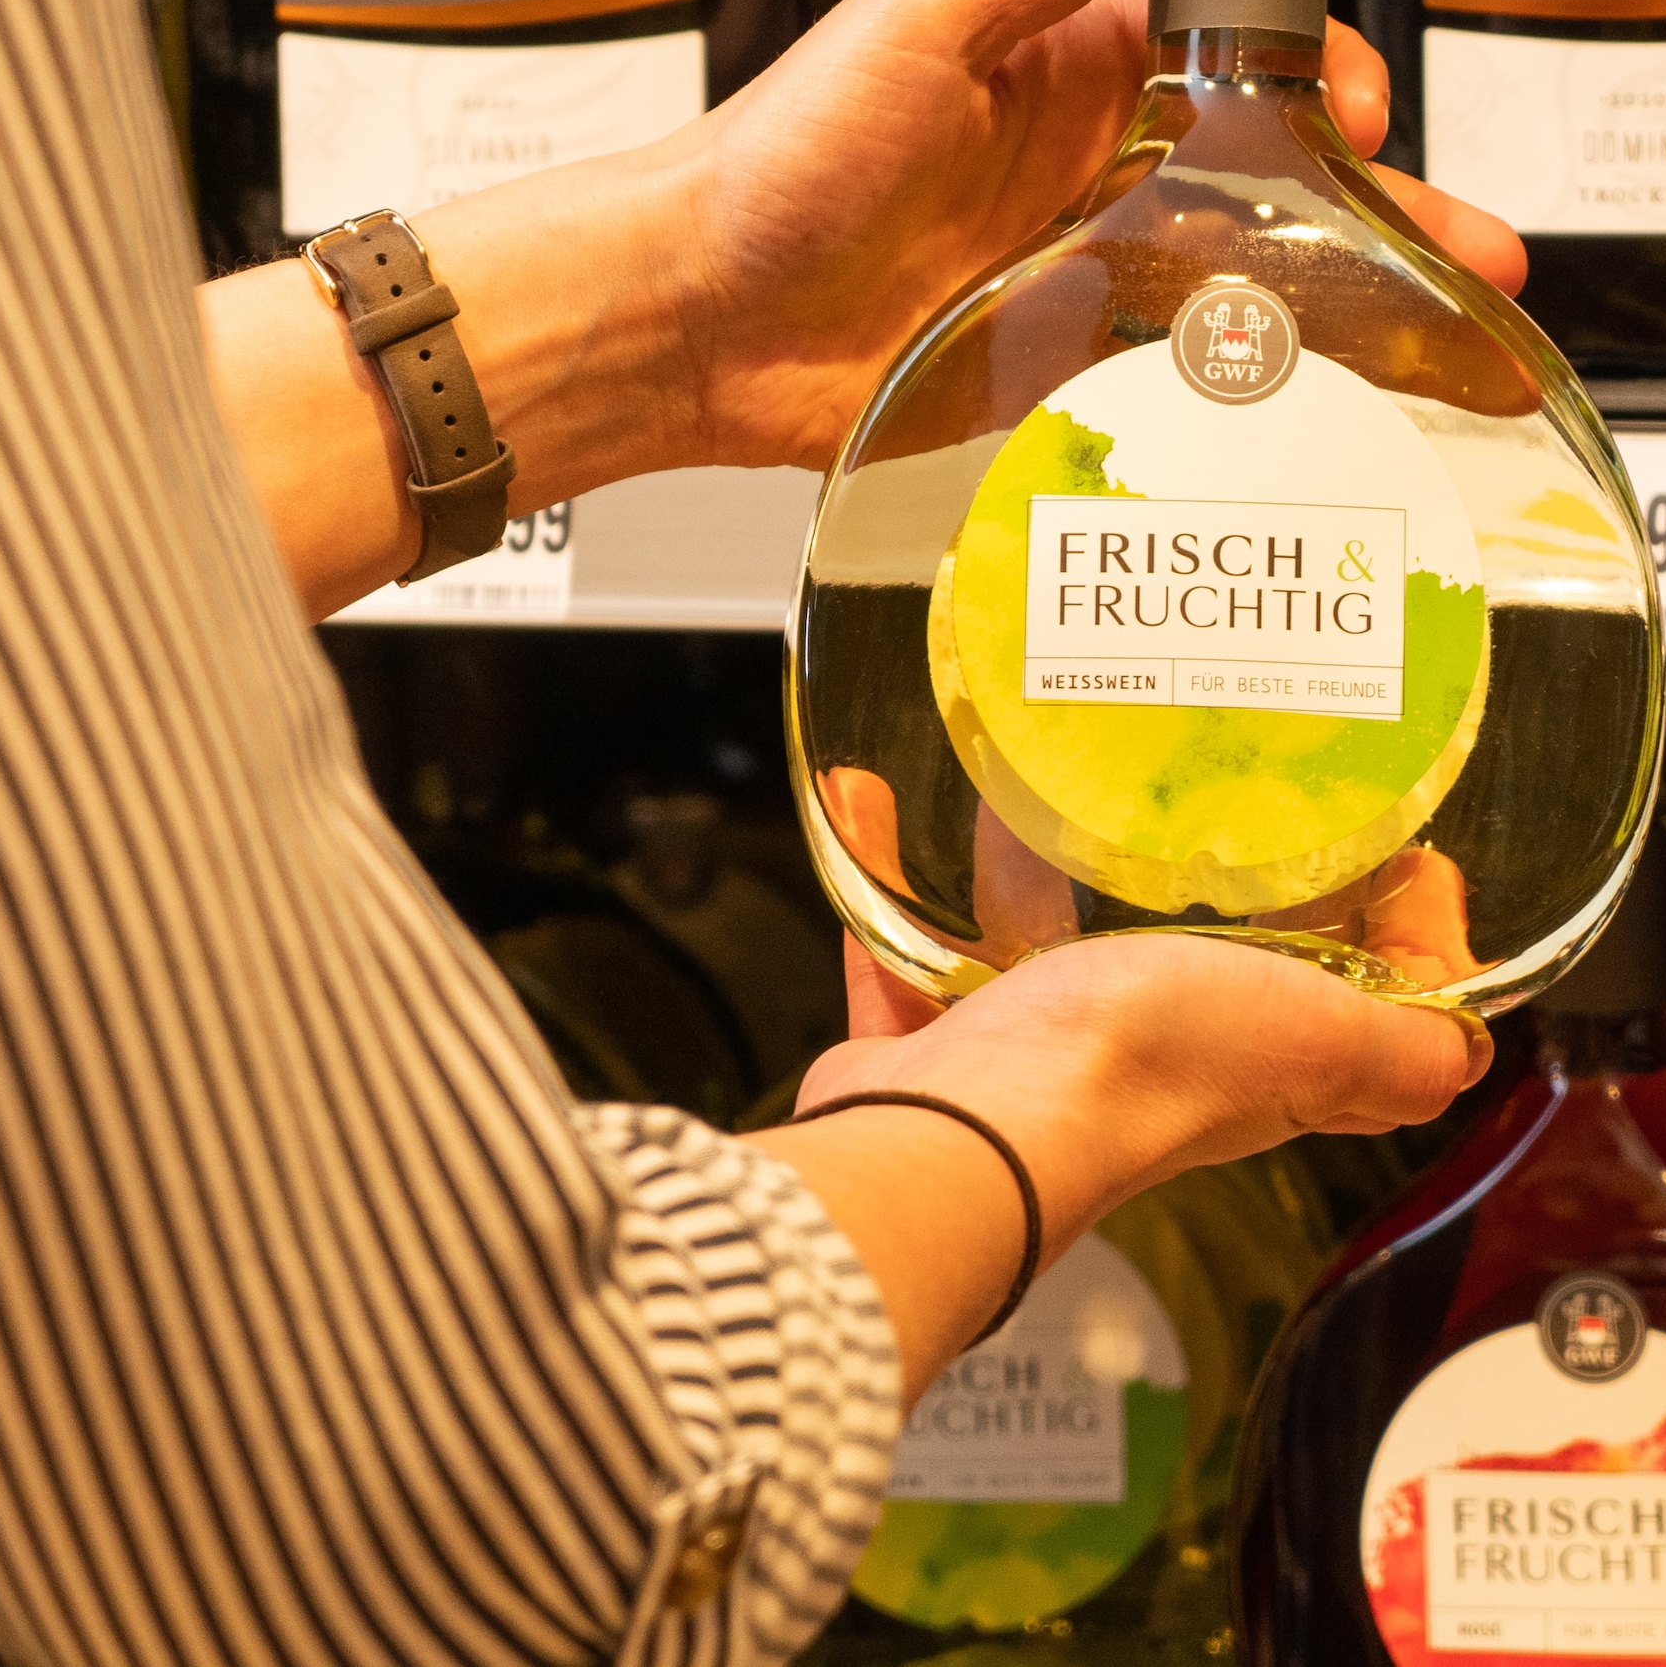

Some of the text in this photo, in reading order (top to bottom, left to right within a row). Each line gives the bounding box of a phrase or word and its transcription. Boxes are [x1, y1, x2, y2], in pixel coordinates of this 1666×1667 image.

[1203, 360, 1264, 384] GWF
[1059, 531, 1377, 583] FRISCH &
[1058, 584, 1373, 635] FRUCHTIG
[1041, 673, 1157, 691] WEISSWEIN
[1190, 672, 1388, 699] FÜR BESTE FREUNDE
[1453, 1498, 1666, 1536] FRISCH
